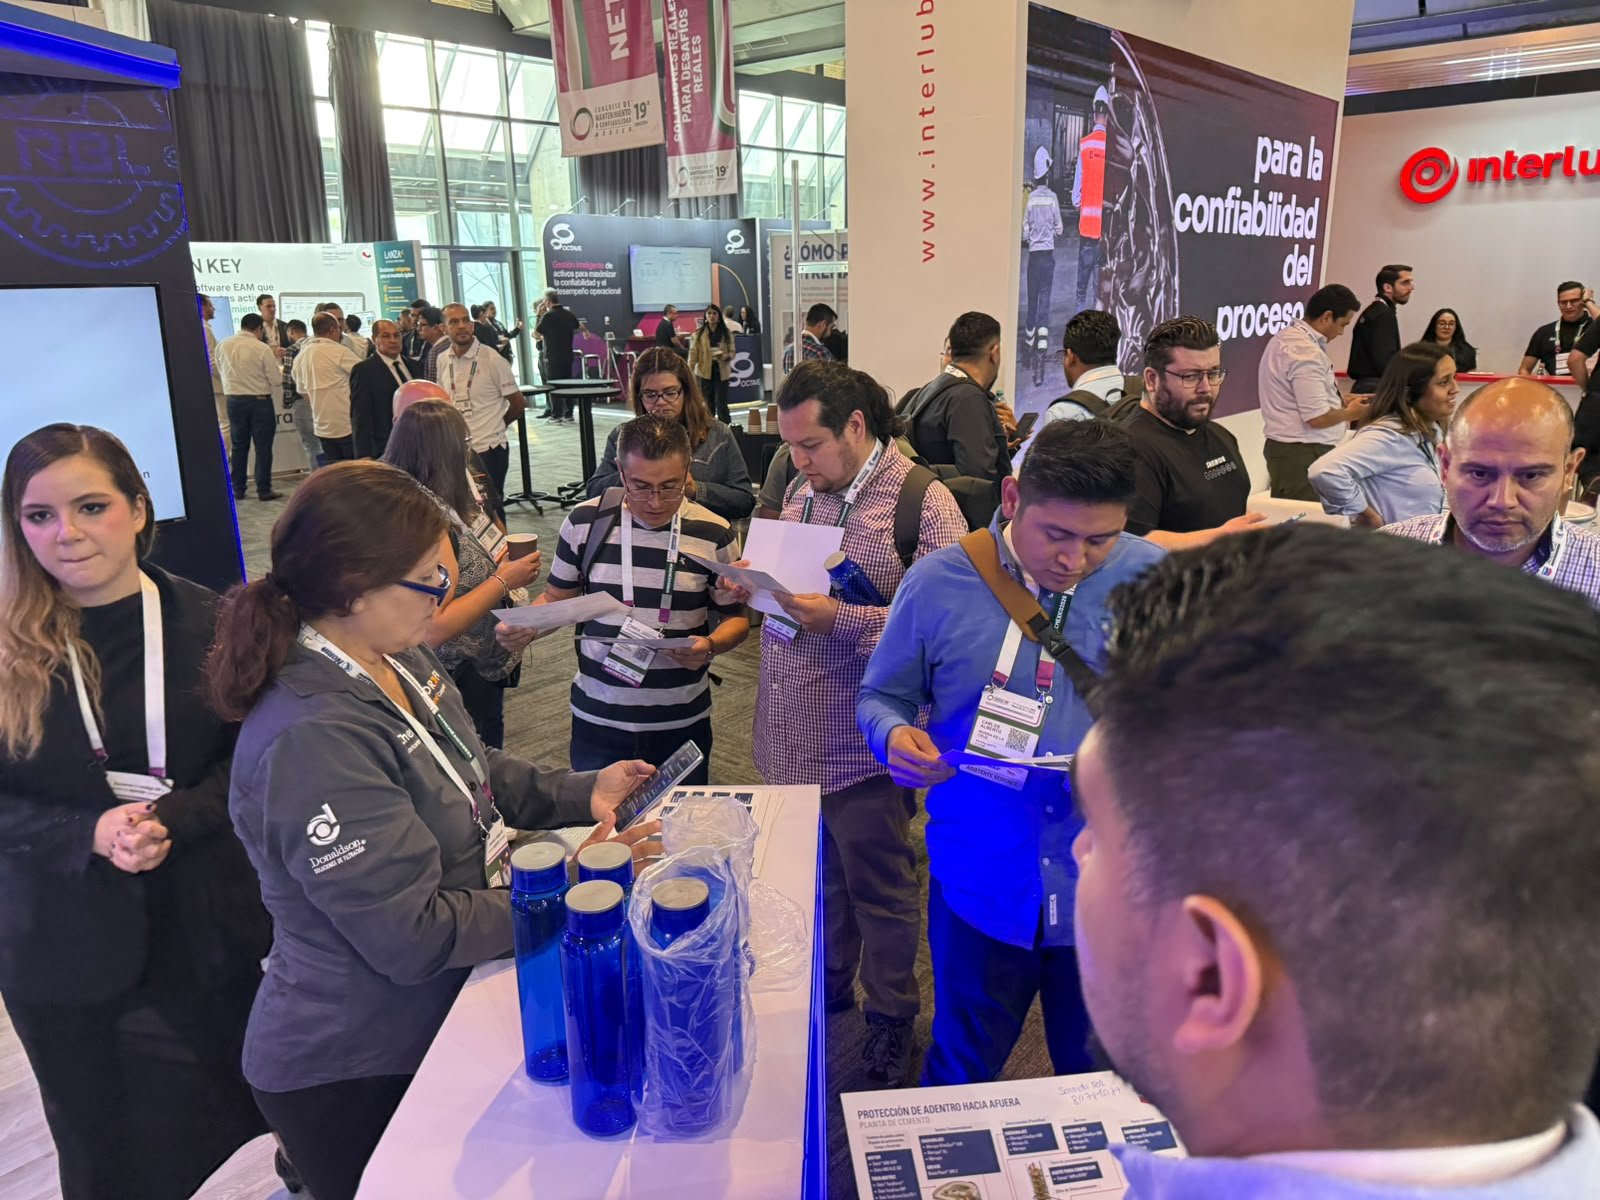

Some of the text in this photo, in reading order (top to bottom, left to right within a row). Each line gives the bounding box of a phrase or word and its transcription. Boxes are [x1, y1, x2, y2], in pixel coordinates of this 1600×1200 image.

[692, 34, 704, 93] REALES
[681, 84, 693, 124] PARA
[1254, 136, 1324, 184] para la
[1174, 186, 1320, 239] confiabilidad
[784, 241, 834, 261] ¿ÓMO
[206, 258, 241, 274] KEY
[552, 261, 576, 269] Gestión
[1282, 243, 1315, 287] del
[233, 283, 255, 292] EAM
[590, 287, 622, 296] operacional
[1216, 301, 1305, 341] proceso
[857, 1097, 1021, 1119] PROTECCIÓN DE ADENTRO HACIA AFUERA
[859, 1116, 930, 1128] PLANTA DE CEMENTO
